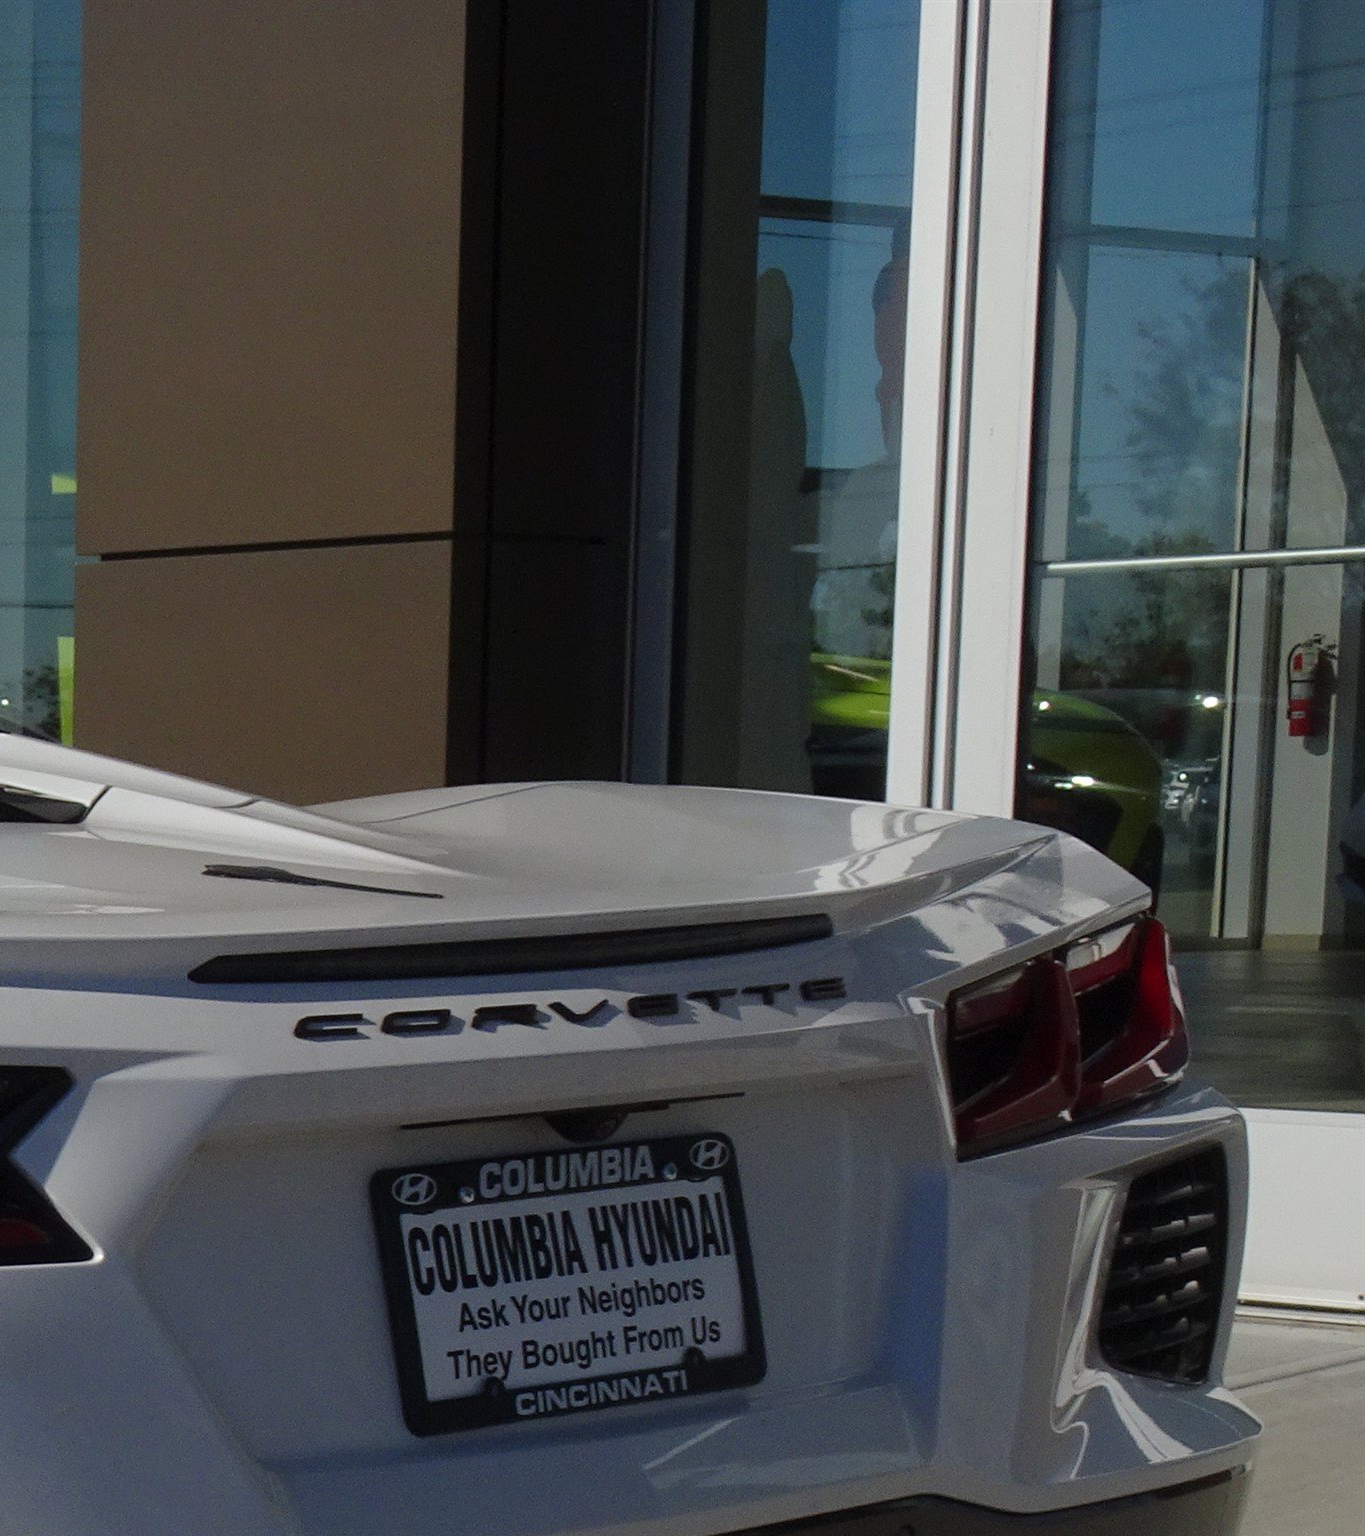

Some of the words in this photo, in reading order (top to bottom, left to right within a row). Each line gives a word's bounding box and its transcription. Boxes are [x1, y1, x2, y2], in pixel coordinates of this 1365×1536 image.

[293, 977, 847, 1041] CORVETTE
[478, 1145, 656, 1200] COLUMBIA
[407, 1209, 589, 1296] COLUMBIA
[587, 1191, 732, 1272] HYUNDAI
[458, 1299, 510, 1333] Ask
[510, 1293, 570, 1324] Your
[577, 1277, 706, 1318] Neighbors
[446, 1349, 514, 1381] They
[521, 1330, 617, 1370] Bought
[622, 1323, 685, 1355] From
[690, 1315, 721, 1346] Us
[515, 1369, 689, 1417] CINCINNATI
